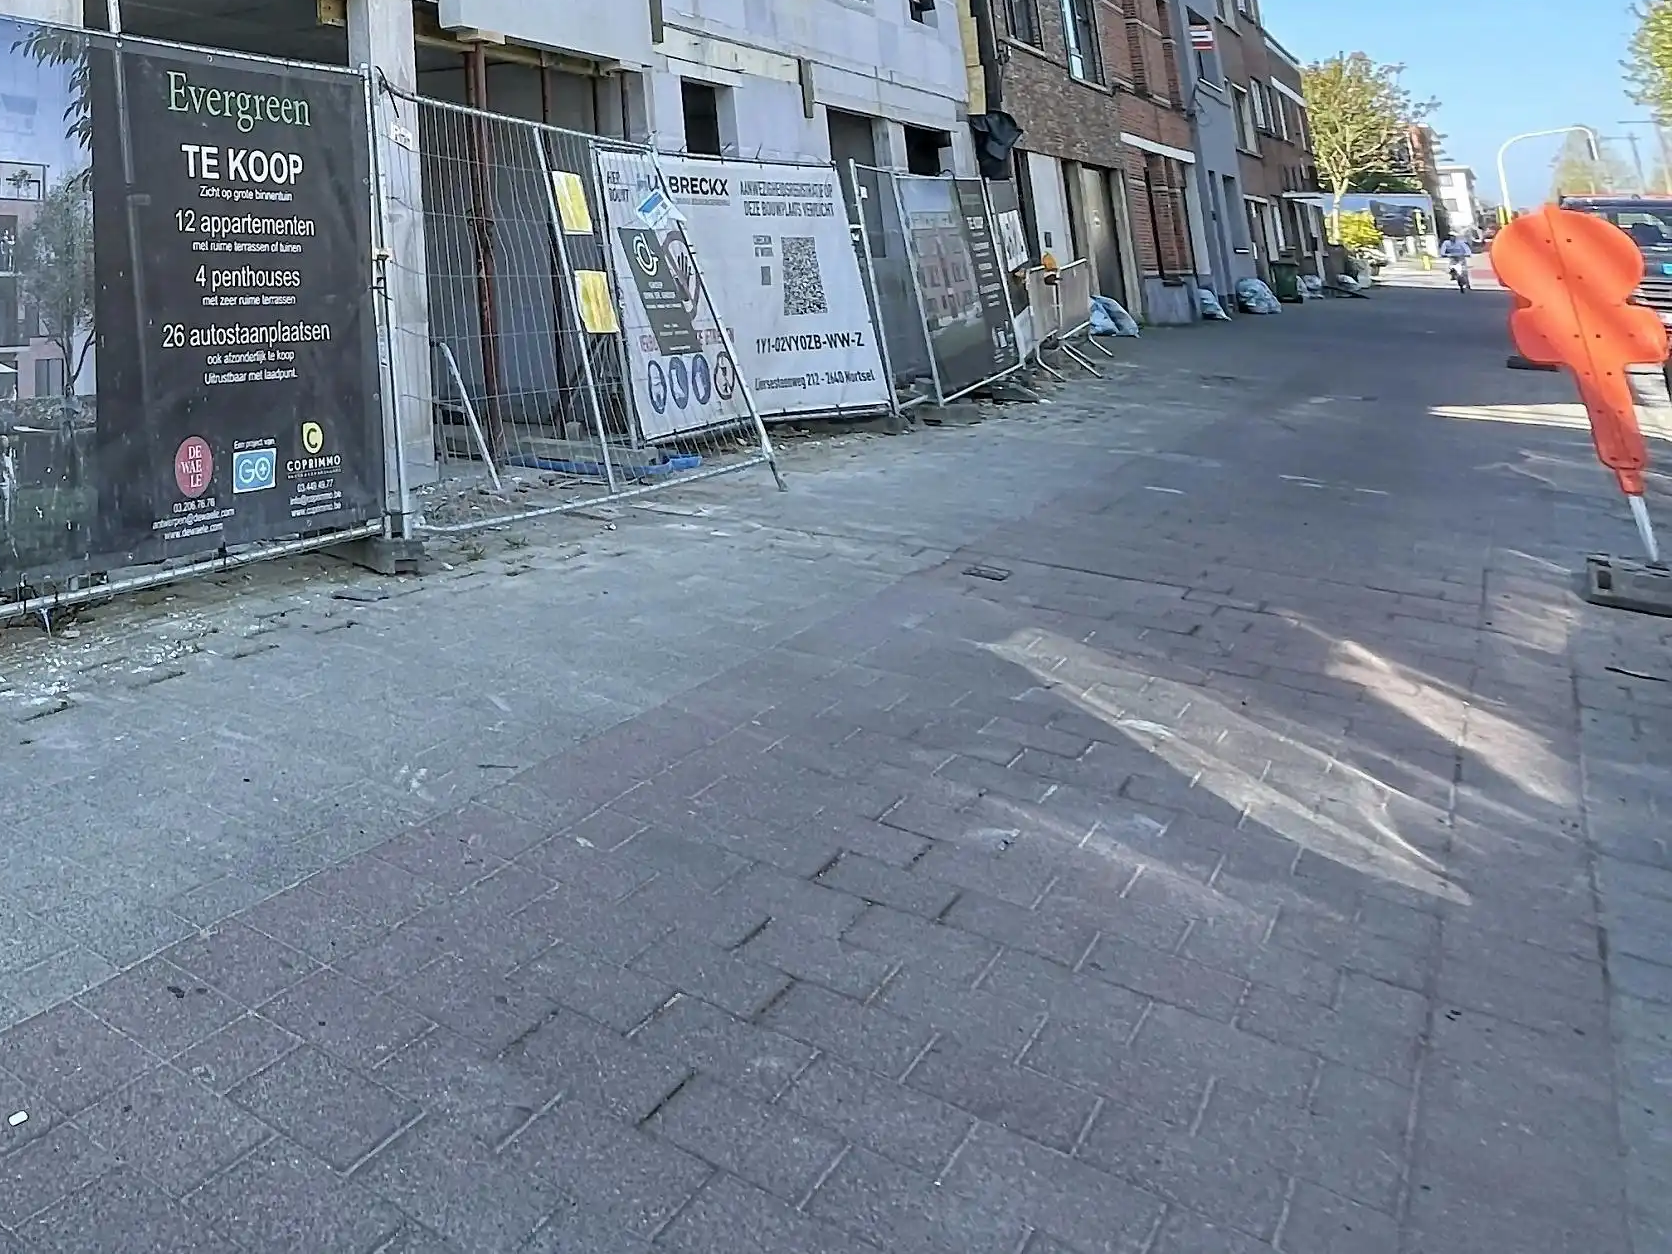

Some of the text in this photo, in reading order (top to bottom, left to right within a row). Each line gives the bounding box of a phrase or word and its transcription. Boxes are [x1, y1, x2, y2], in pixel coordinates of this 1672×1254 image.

[166, 70, 311, 133] Evergreen
[181, 144, 303, 185] TE KOOP
[636, 173, 729, 196] HUBRECKX
[199, 185, 220, 198] Zicht
[221, 189, 232, 200] op
[233, 189, 254, 201] grote
[175, 209, 315, 238] 12 appartementen
[192, 240, 302, 253] met ruime terrassen of tuinen
[195, 264, 301, 292] 4 penthouses
[202, 294, 296, 306] met zeer ruime terrassen
[162, 320, 331, 348] 26 autostaanplaatsen
[207, 349, 295, 365] ook afzonderlijk te koop
[204, 371, 247, 385] Uitrustbaar
[248, 369, 263, 381] met
[188, 445, 202, 459] DE
[180, 459, 203, 474] WAE
[286, 454, 341, 472] COPRIMMO
[190, 473, 203, 488] LE
